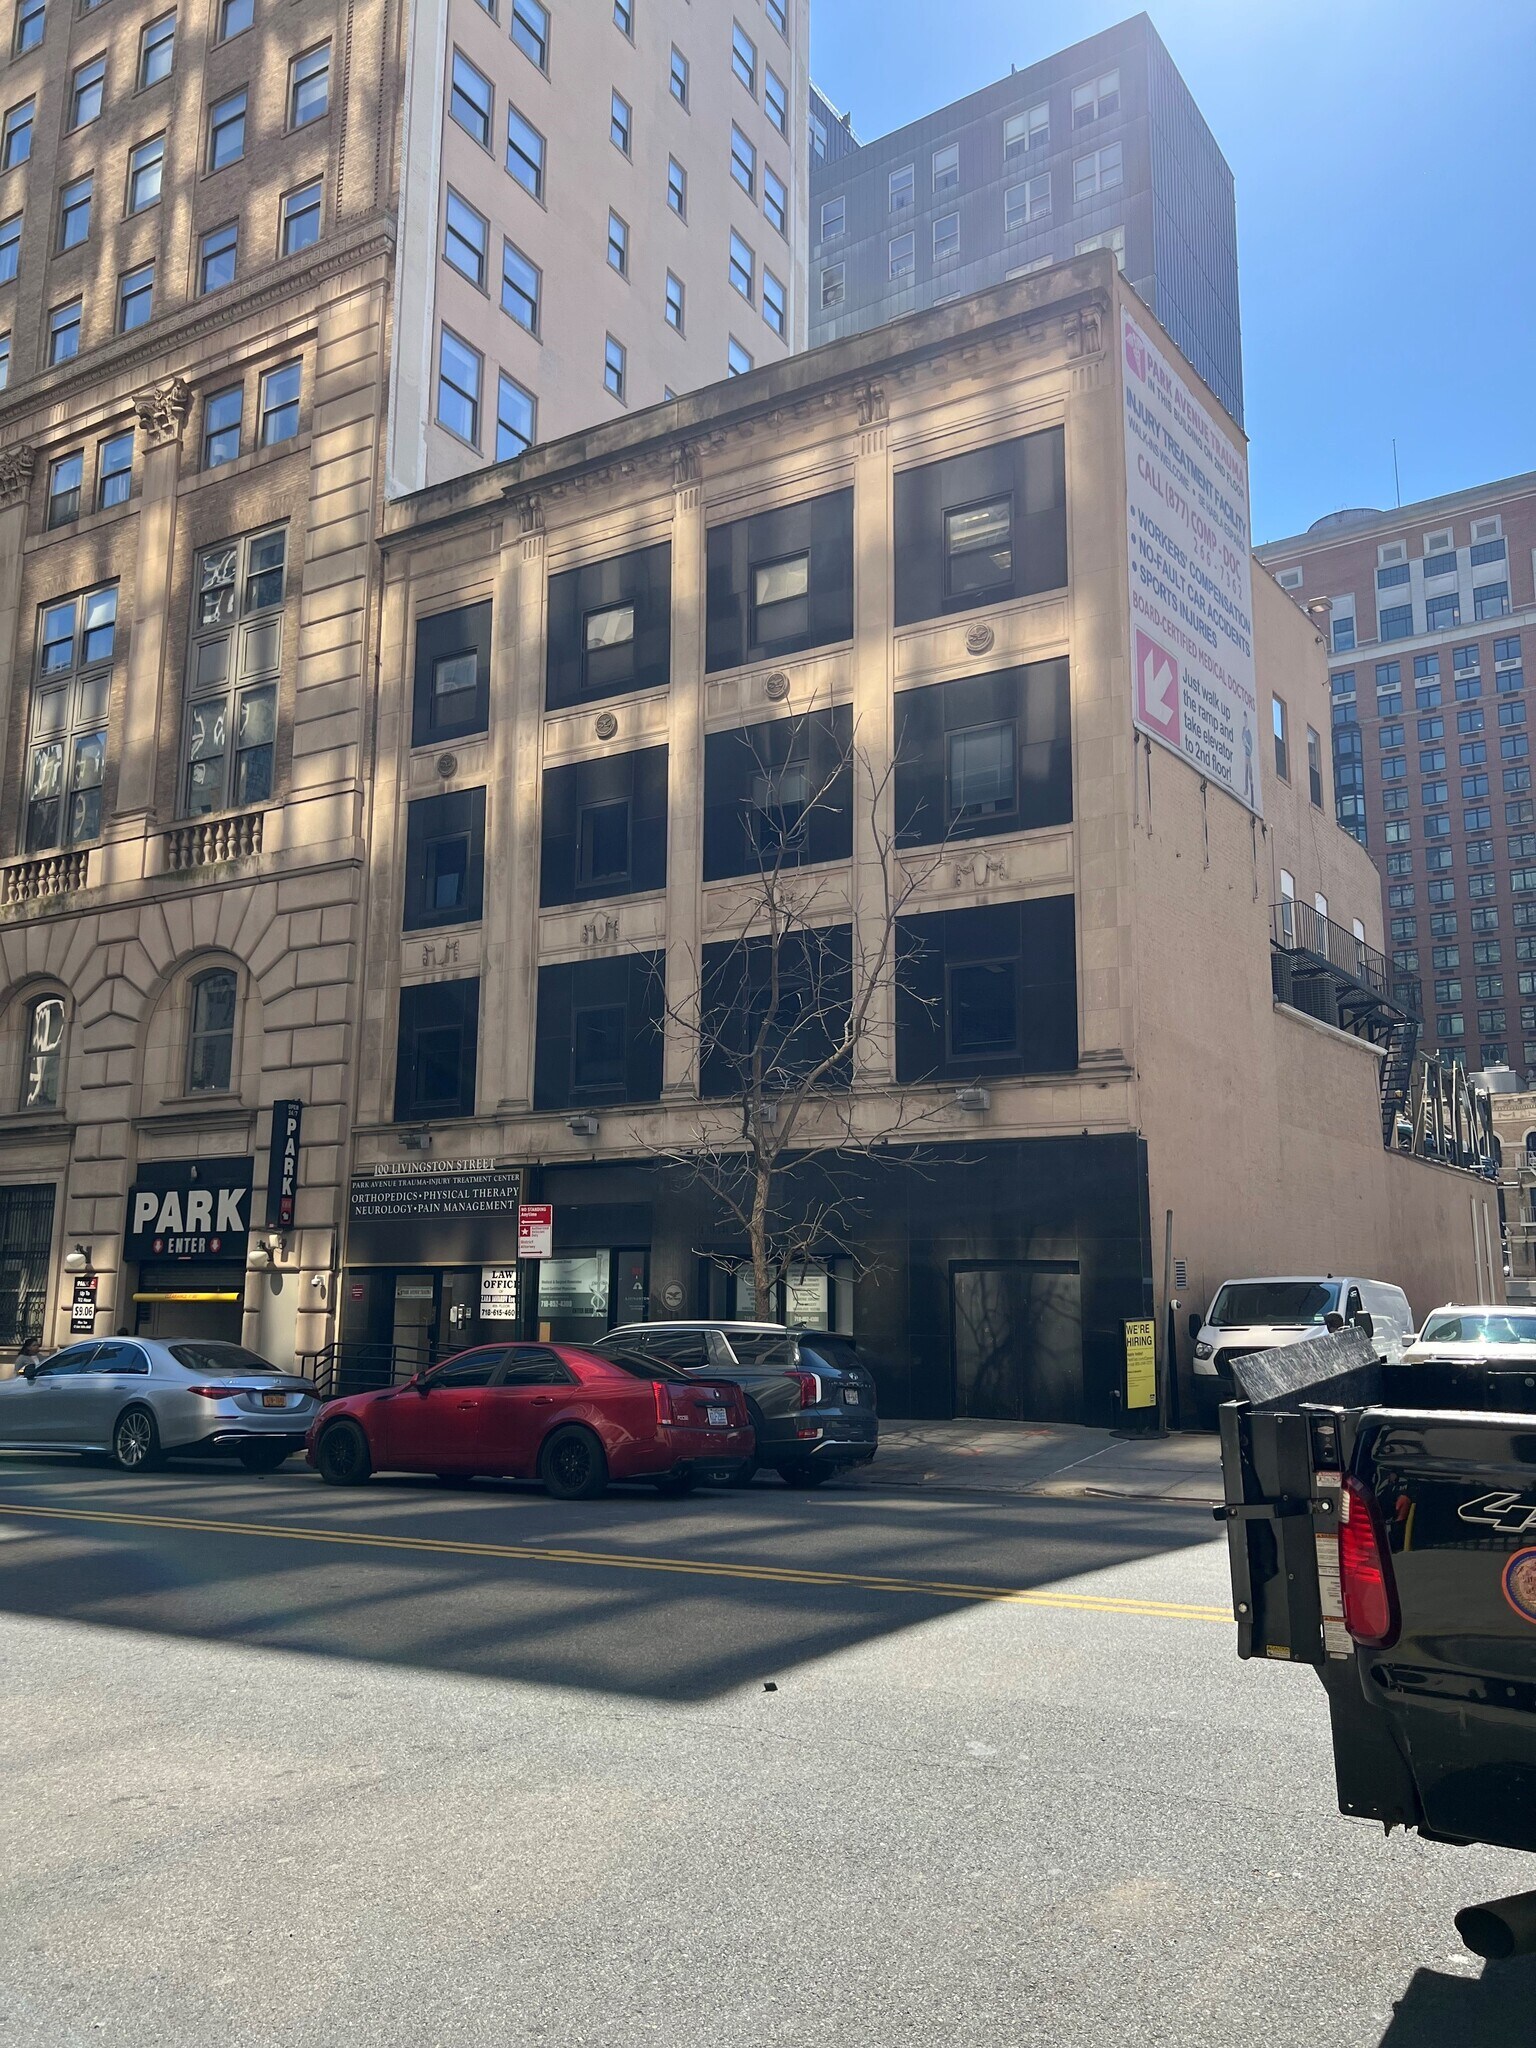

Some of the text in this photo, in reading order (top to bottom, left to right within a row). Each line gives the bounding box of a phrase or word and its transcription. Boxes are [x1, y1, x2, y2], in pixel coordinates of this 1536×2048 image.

[1147, 352, 1244, 486] PARK AVENUE TRAUMA
[1148, 376, 1245, 501] IN THIS BUILDING ON 2ND FLOOR
[1126, 385, 1246, 538] INJURY TREATMENT FACILITY
[1128, 414, 1159, 457] WALK-INS
[1160, 449, 1189, 491] WELCOME
[1198, 493, 1206, 510] SE
[1206, 503, 1223, 528] HABLA
[1138, 452, 1164, 498] CALL
[1166, 481, 1189, 529] (877)
[1138, 507, 1251, 636] WORKERS' COMPENSATION
[1139, 536, 1251, 658] NO-FAULT CAR ACCIDENTS
[1140, 564, 1217, 649] SPORTS INJURIES
[1133, 590, 1255, 712] BOARD-CERTIFIED MEDICAL DOCTORS
[1183, 667, 1231, 722] Just walk up
[1183, 689, 1234, 743] the ramp and
[1184, 711, 1233, 763] take elevator
[1185, 734, 1232, 782] to 2nd floor!
[282, 1118, 297, 1196] PARK
[352, 1181, 370, 1189] PARK
[371, 1180, 397, 1188] AVENUE
[453, 1175, 493, 1184] TREATMENT
[493, 1174, 520, 1182] CENTER
[374, 1158, 496, 1175] 100 LIVINGSTON STREET
[133, 1188, 247, 1234] PARK
[351, 1187, 520, 1203] ORTHOPEDICS PHYSICAL THERAPY
[355, 1200, 515, 1215] NEUROLOGY PAIN MANAGEMENT
[168, 1238, 206, 1254] ENTER
[484, 1280, 516, 1289] OFFIC
[492, 1270, 514, 1279] LAW
[75, 1307, 93, 1316] $9.06
[1126, 1324, 1150, 1335] WE'RE
[1127, 1336, 1152, 1347] HIRING
[1458, 1492, 1536, 1533] 4
